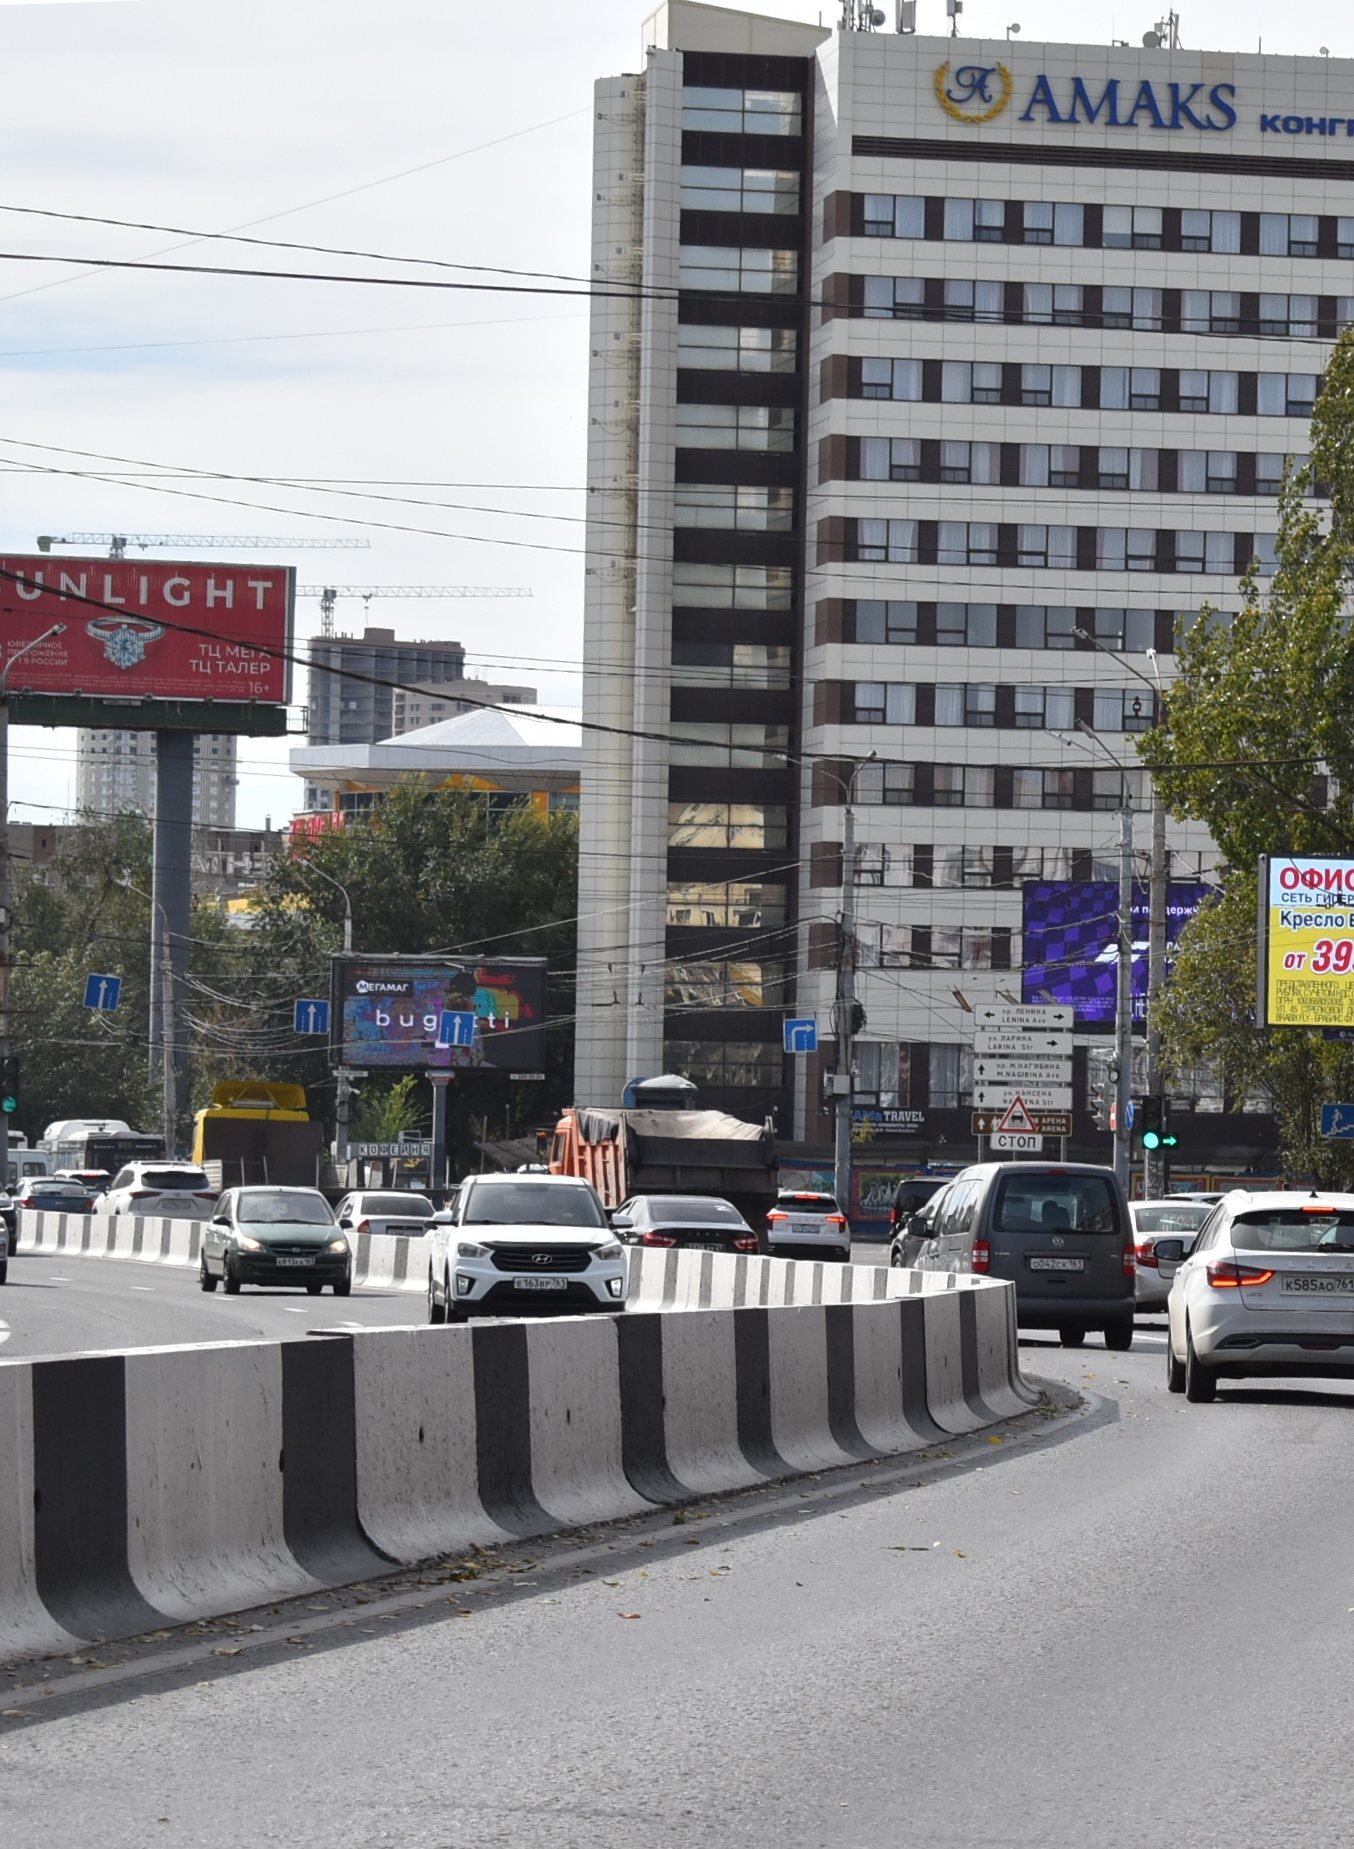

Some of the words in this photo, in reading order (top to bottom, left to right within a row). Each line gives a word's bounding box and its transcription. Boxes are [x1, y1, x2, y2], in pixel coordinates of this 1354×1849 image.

[1018, 74, 1238, 131] AMAKS
[0, 570, 273, 610] UNLIGHT
[199, 644, 221, 660] ТЦ
[190, 660, 211, 675] ТЦ
[216, 661, 271, 675] ТАЛЕР
[249, 681, 270, 694] 16+
[1281, 893, 1312, 903] СЕТЬ
[1280, 911, 1344, 930] Кресло
[357, 980, 409, 993] МЕГАМАГ
[375, 1009, 510, 1031] bugti
[883, 1110, 925, 1122] TRAVEL
[998, 1135, 1036, 1149] СТОП
